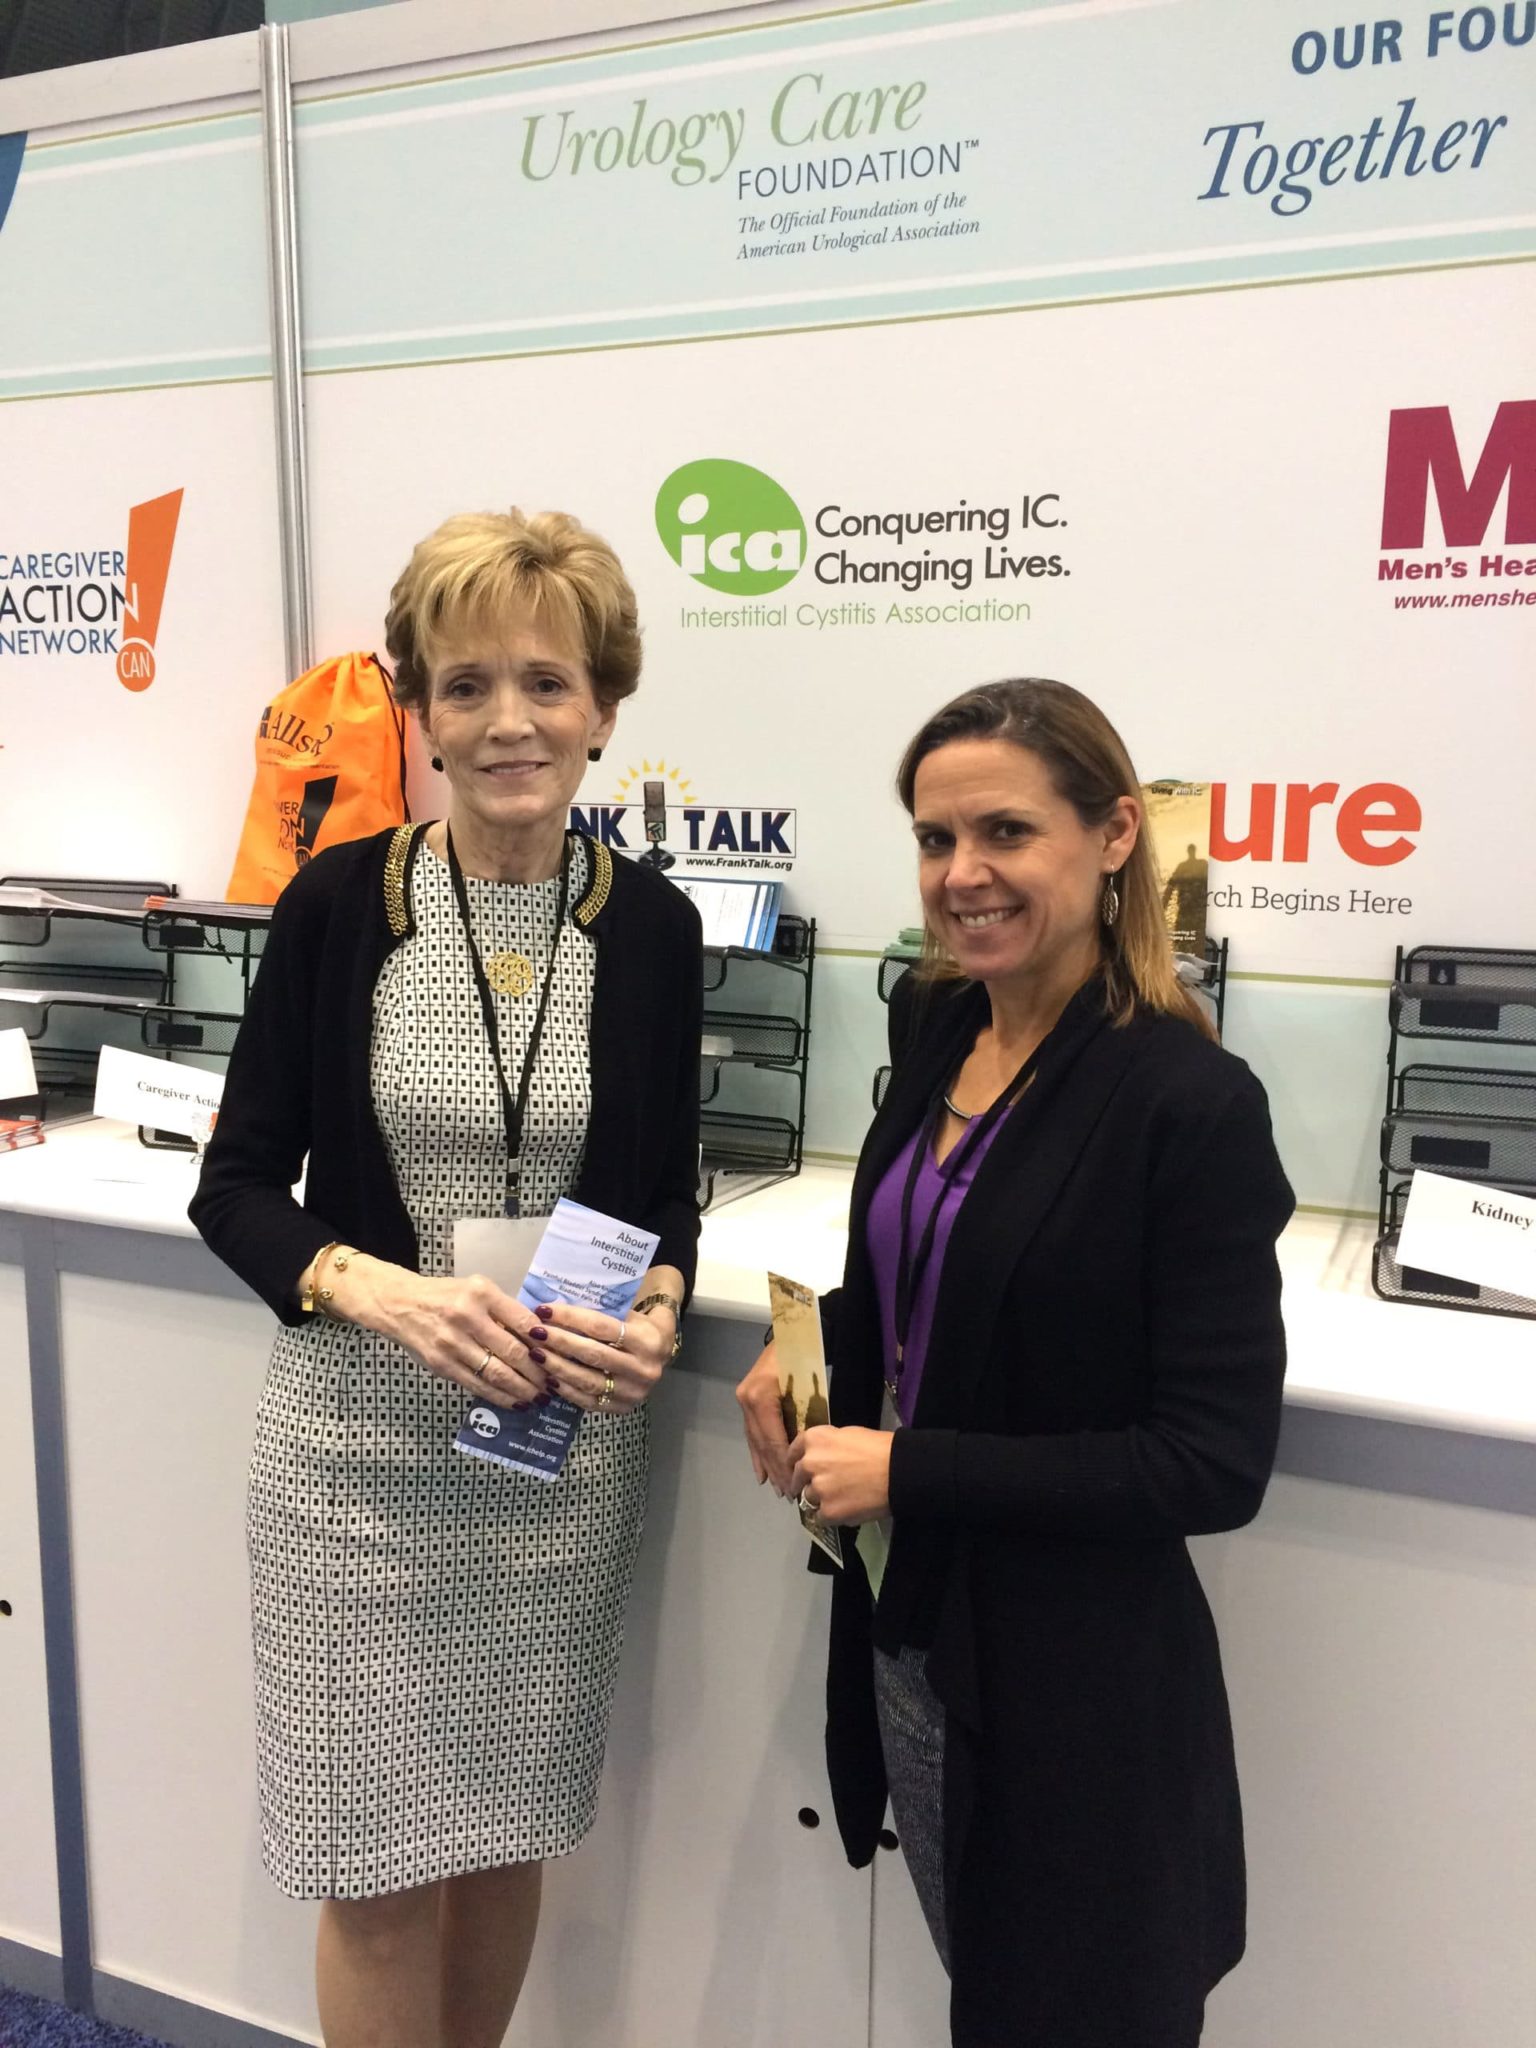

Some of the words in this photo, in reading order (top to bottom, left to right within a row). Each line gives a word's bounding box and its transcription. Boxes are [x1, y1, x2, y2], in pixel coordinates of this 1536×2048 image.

[1291, 19, 1403, 75] OUR
[1427, 0, 1536, 58] FOU
[520, 99, 746, 187] Urology
[770, 73, 927, 148] Care
[1197, 97, 1508, 216] Together
[737, 214, 766, 235] The
[769, 206, 826, 233] Official
[828, 198, 919, 224] Foundation
[923, 193, 942, 216] of
[943, 191, 968, 210] the
[736, 239, 807, 260] American
[812, 226, 888, 252] Urological
[891, 218, 981, 242] Association
[815, 499, 1010, 545] Conquering
[1021, 493, 1069, 530] IC.
[678, 493, 801, 575] ica
[814, 546, 973, 592] Changing
[984, 545, 1071, 580] Lives.
[1378, 556, 1468, 581] Men's
[0, 582, 140, 624] ACTION
[680, 604, 788, 629] Interstitial
[796, 601, 876, 631] Cystitis
[885, 598, 1031, 625] Association
[0, 628, 119, 656] NETWORK
[119, 651, 151, 679] CAN
[683, 809, 792, 854] TALK
[686, 857, 793, 871] www.FrankTalk.org
[1251, 886, 1341, 915] Begins
[1348, 889, 1413, 915] Here
[137, 1081, 191, 1101] Caregiver
[1472, 1200, 1534, 1231] Kidney
[590, 1236, 644, 1264] Interstitial
[616, 1232, 649, 1251] About
[601, 1256, 638, 1278] Cystitis
[472, 1412, 499, 1436] ica
[527, 1427, 564, 1445] Association
[544, 1424, 567, 1437] Cystitis
[507, 1440, 558, 1462] www.ichelp.org
